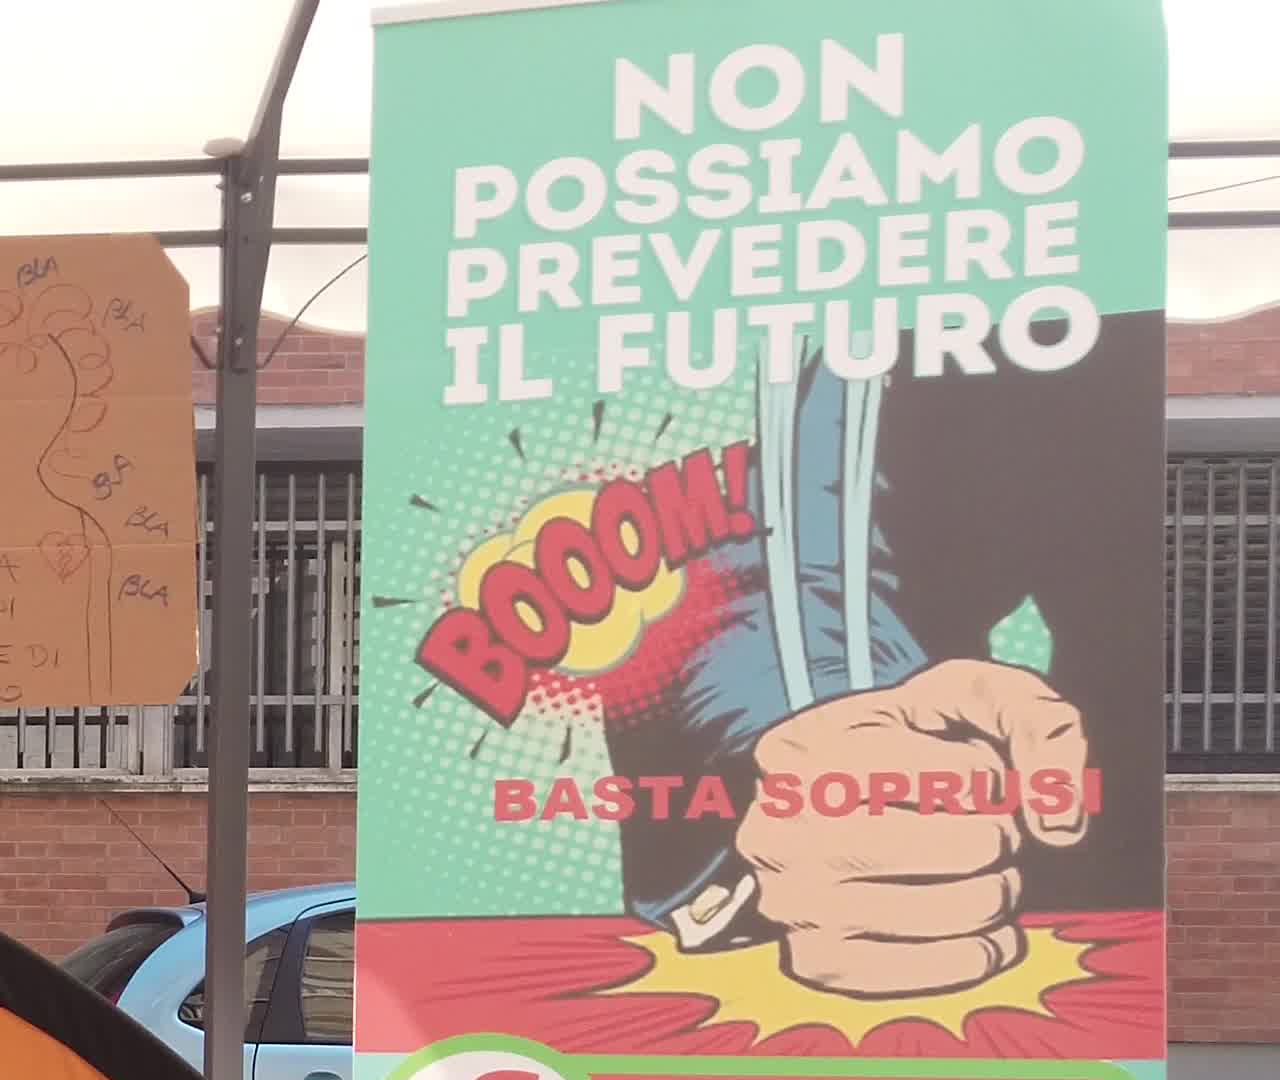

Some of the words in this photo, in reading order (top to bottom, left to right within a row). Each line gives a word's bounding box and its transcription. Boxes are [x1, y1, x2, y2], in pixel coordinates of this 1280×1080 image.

[614, 32, 904, 140] NON
[453, 115, 1085, 239] POSSIAMO
[17, 256, 58, 288] BLA
[446, 201, 1081, 318] PREVEDERE
[442, 322, 553, 405] IL
[596, 285, 1102, 393] FUTURO
[119, 573, 169, 609] BLA
[414, 439, 757, 729] BOOOM!
[26, 643, 60, 669] DI
[493, 774, 735, 823] BASTA
[760, 766, 1103, 820] SOPRUSI
